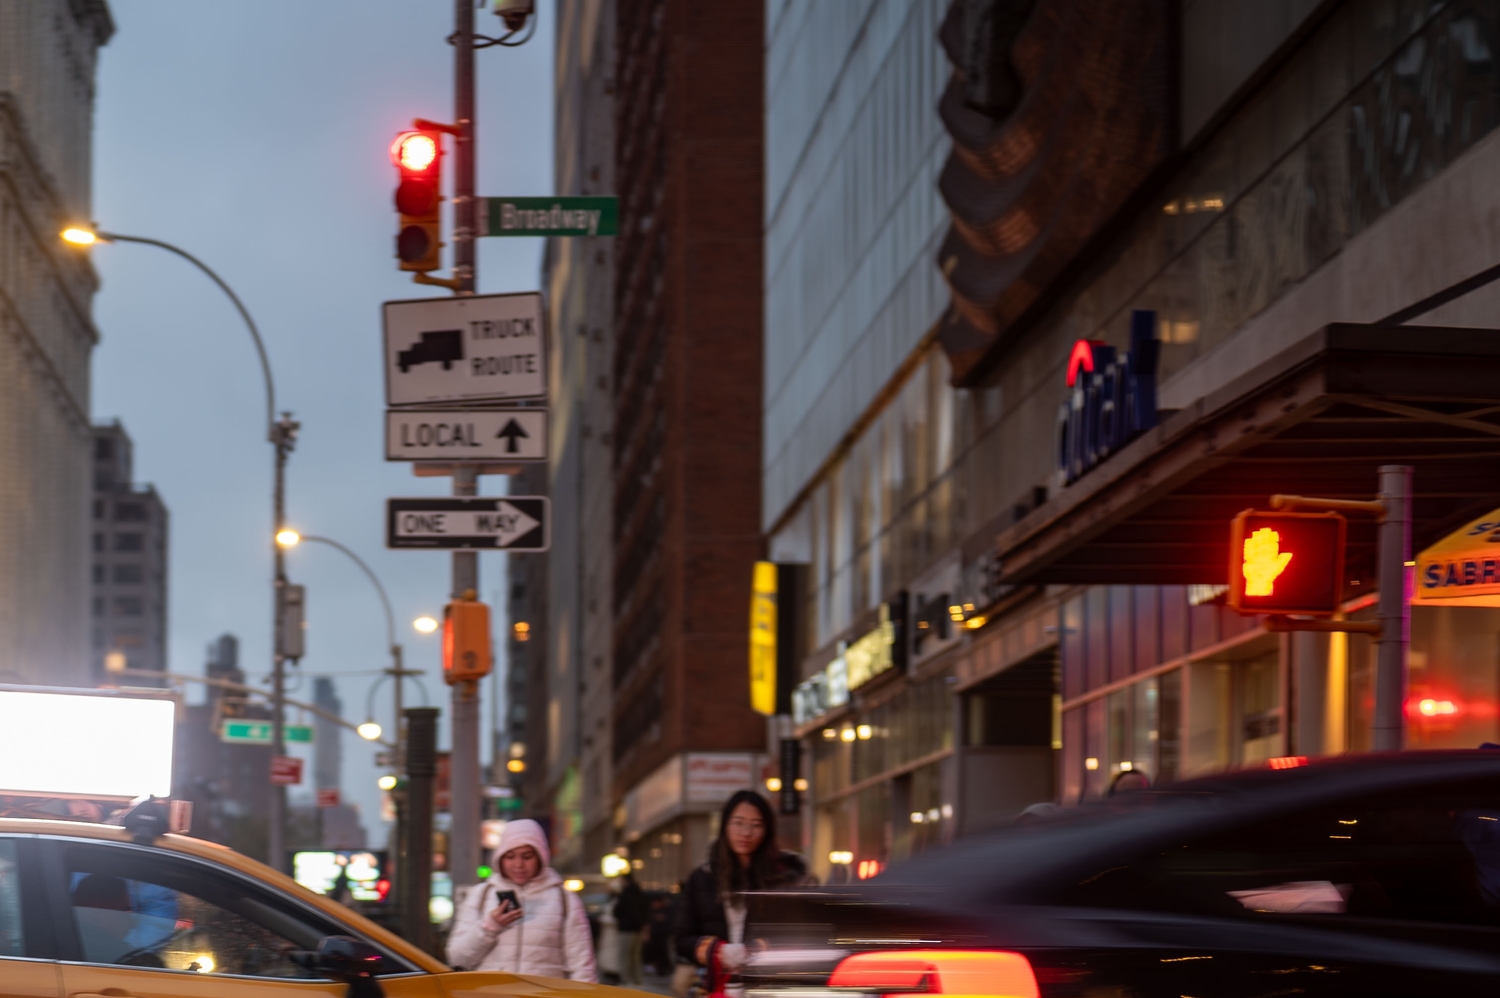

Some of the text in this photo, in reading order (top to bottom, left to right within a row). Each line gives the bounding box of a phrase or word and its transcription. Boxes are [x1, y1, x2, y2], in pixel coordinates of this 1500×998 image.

[501, 203, 601, 236] Broadway
[469, 317, 537, 340] TRUCK
[470, 353, 538, 376] ROUTE
[401, 422, 482, 447] LOCAL
[403, 513, 521, 534] ONE WAY
